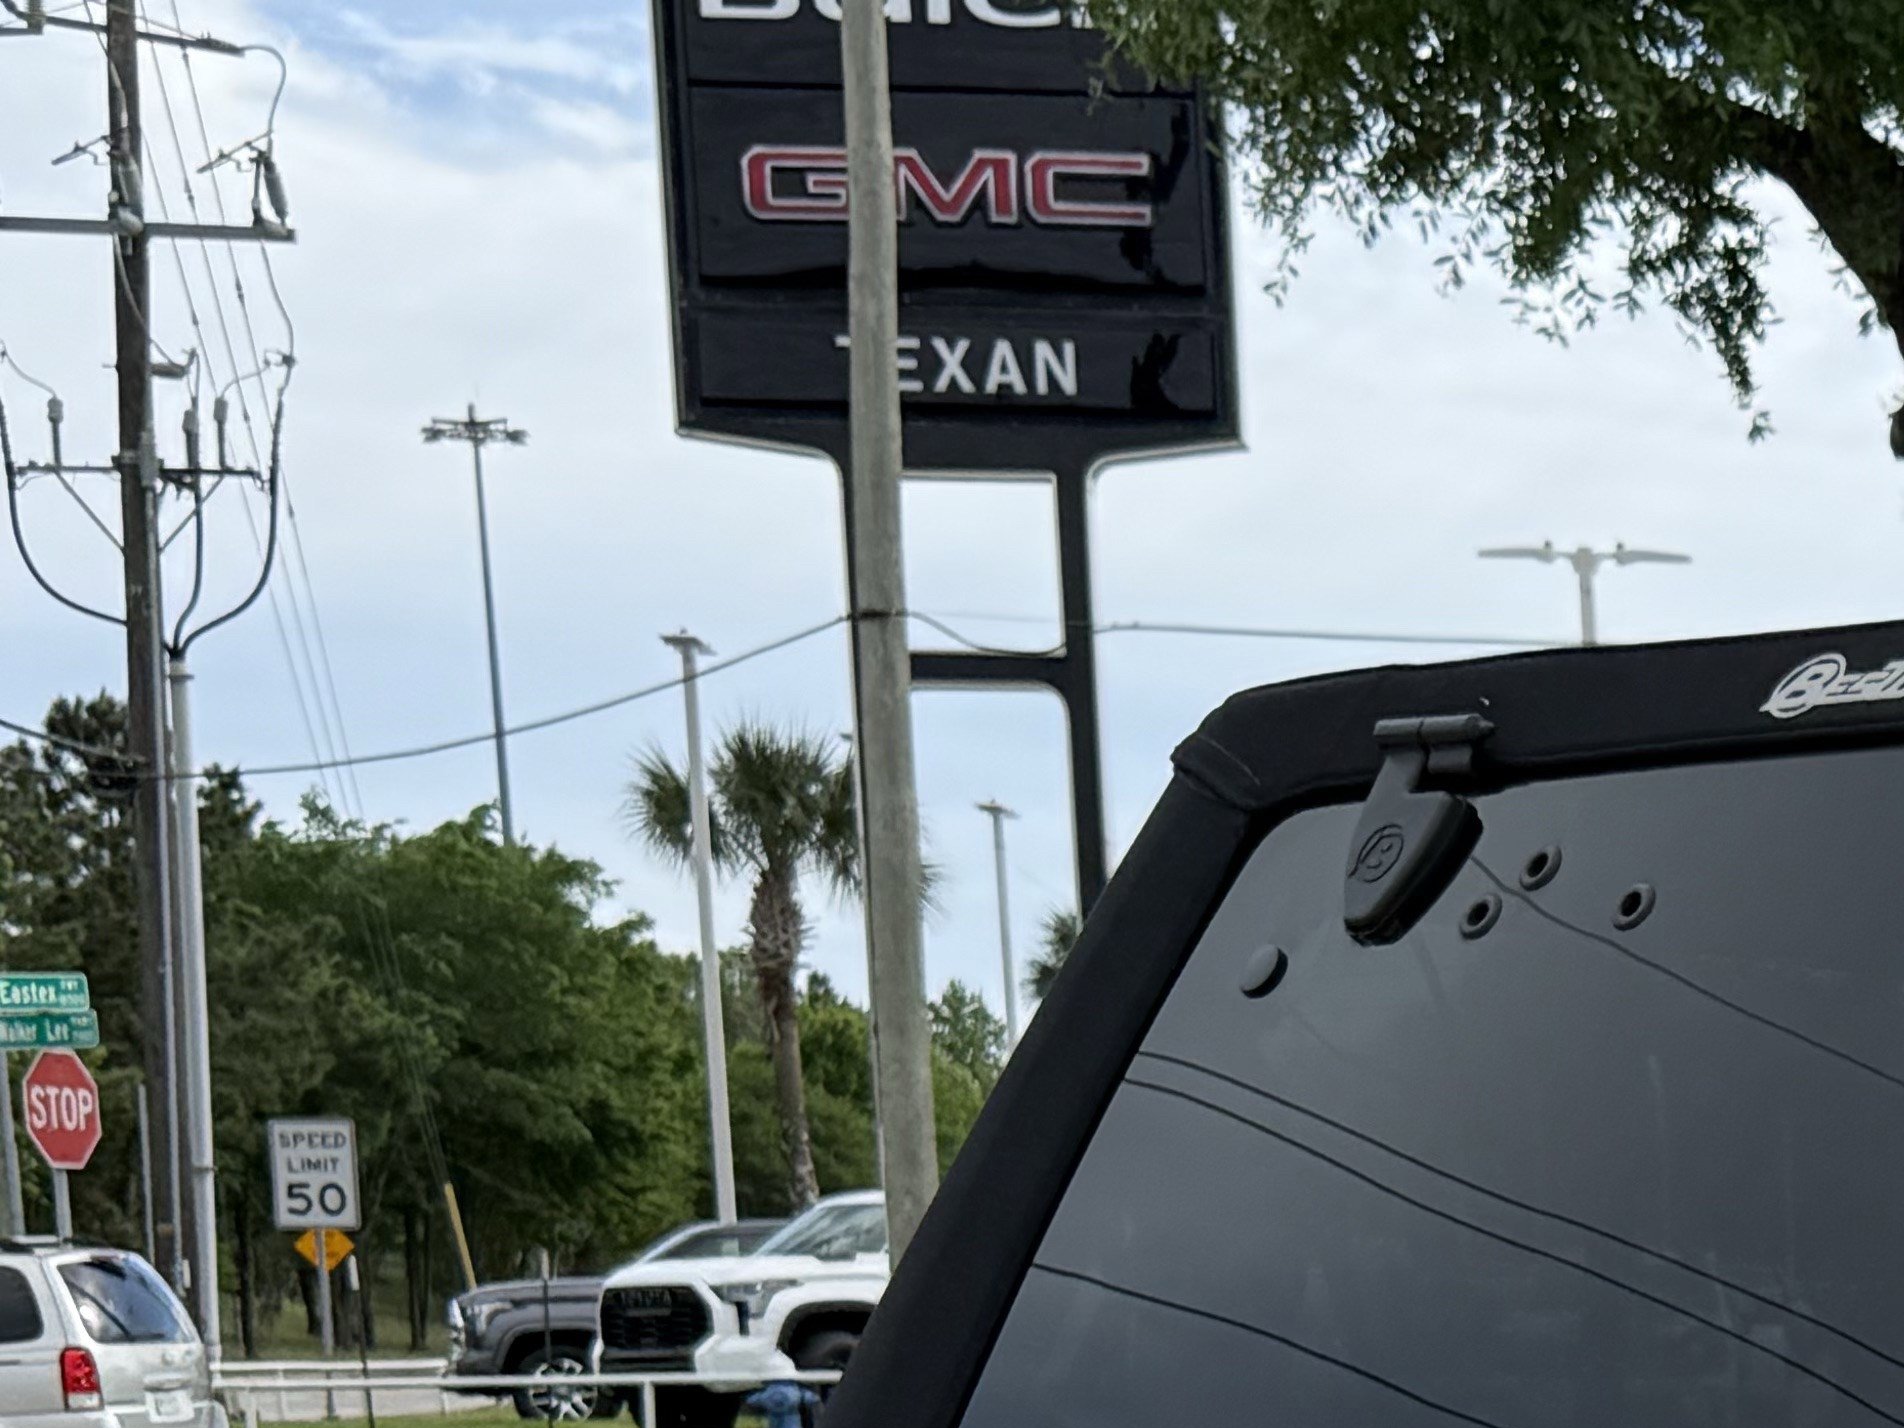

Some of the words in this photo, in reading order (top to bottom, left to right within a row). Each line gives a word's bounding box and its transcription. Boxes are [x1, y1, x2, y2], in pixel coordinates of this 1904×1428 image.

[741, 143, 1151, 226] GMC
[30, 1085, 93, 1131] STOP
[279, 1130, 346, 1149] SPEED
[286, 1156, 339, 1173] LIMIT
[287, 1182, 346, 1216] 50
